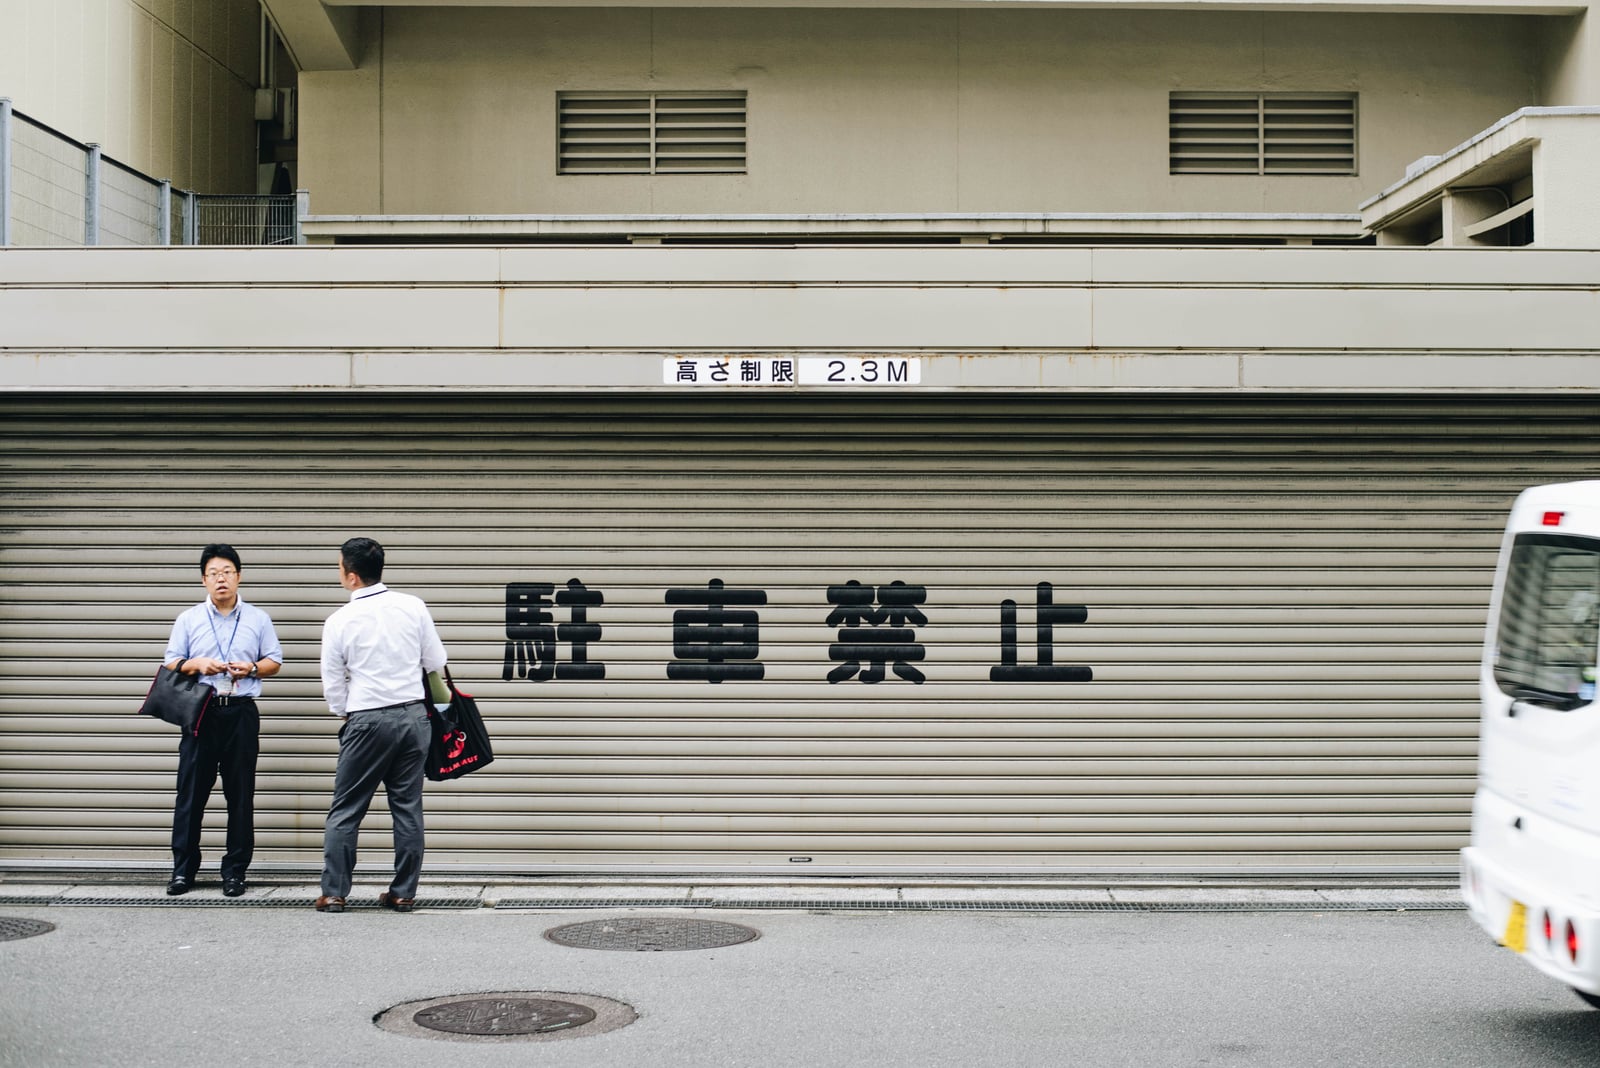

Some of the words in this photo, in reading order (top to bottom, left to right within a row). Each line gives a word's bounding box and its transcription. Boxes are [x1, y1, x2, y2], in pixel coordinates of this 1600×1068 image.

[676, 360, 794, 382] 高さ制限
[827, 360, 908, 382] 2.3M
[502, 578, 1093, 684] 駐車禁止
